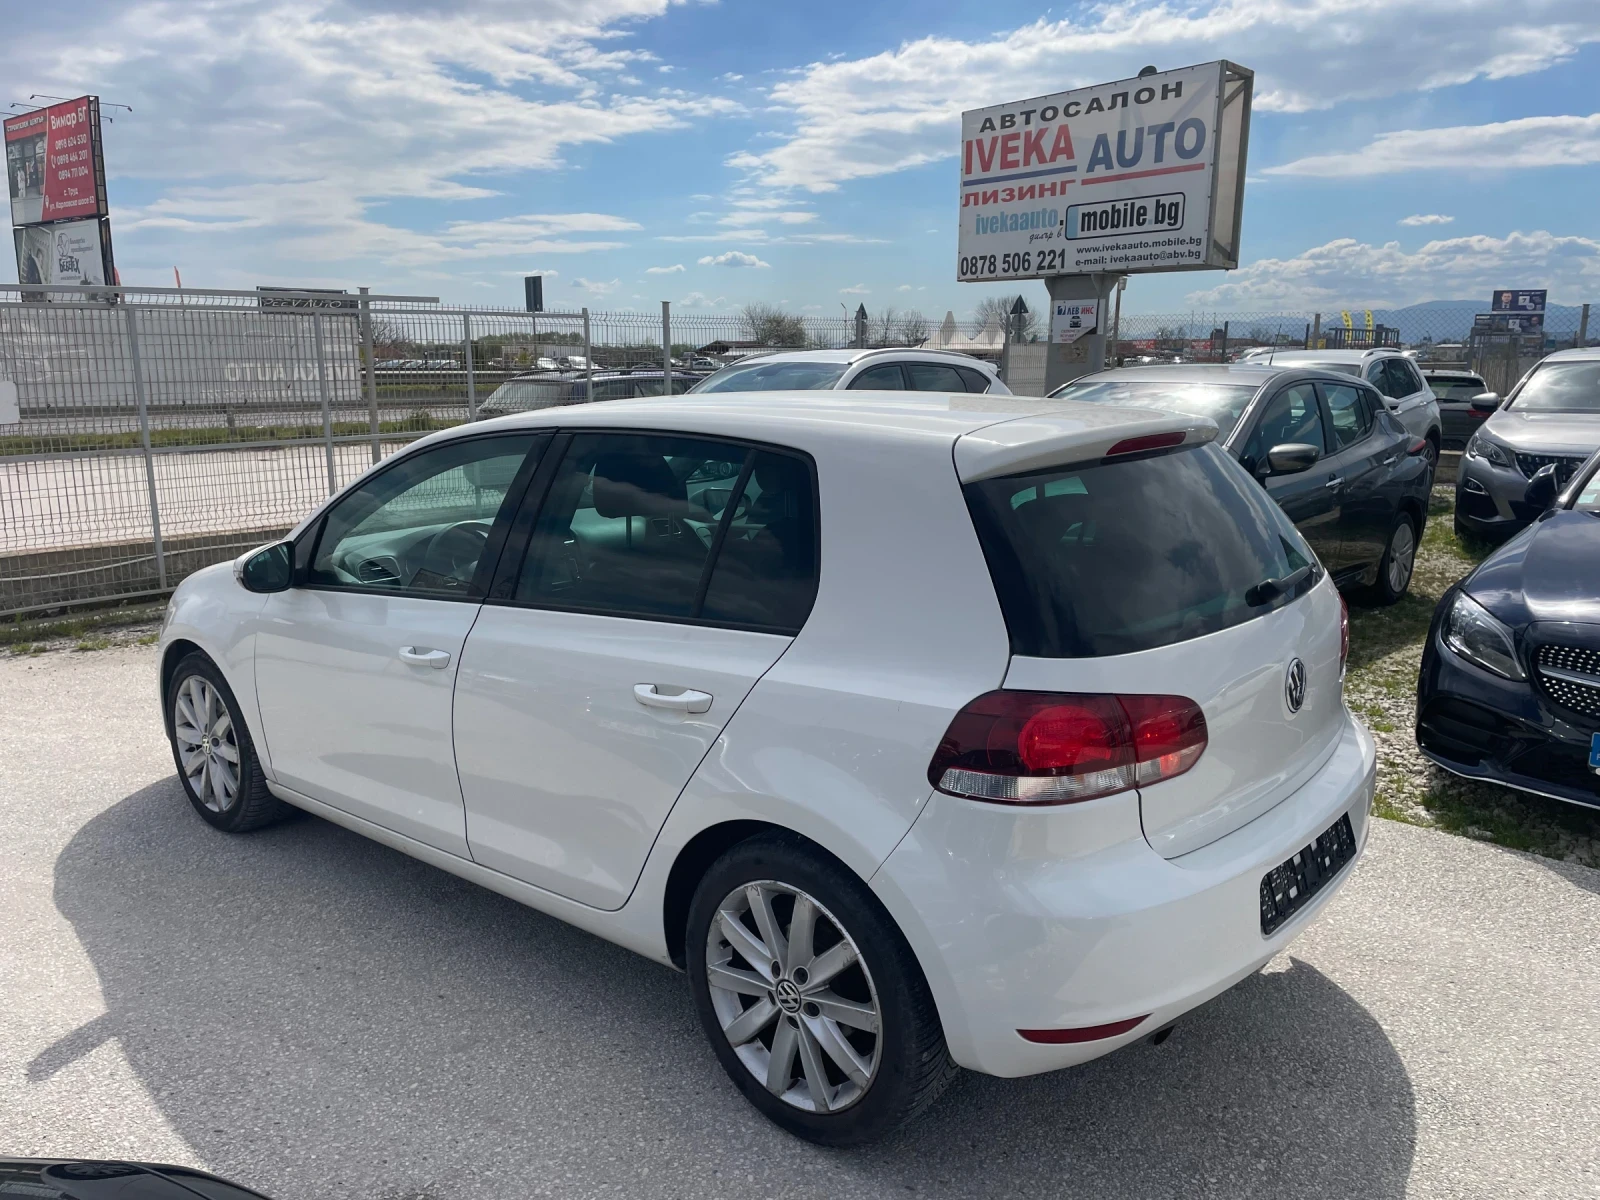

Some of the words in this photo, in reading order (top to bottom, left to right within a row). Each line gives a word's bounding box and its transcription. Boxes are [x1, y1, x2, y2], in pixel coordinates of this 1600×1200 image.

[51, 112, 77, 129] Вимар
[78, 106, 87, 123] БГ
[979, 81, 1183, 133] АВТОСАЛОН
[79, 149, 88, 161] 201
[965, 124, 1075, 175] IVEKA
[1086, 117, 1206, 173] AUTO
[962, 179, 1076, 207] ЛИЗИНГ
[1081, 199, 1180, 227] mobile.bg
[1075, 255, 1107, 266] e-mail:
[1110, 249, 1201, 264] ivekaauto@abv.bg
[1077, 236, 1202, 254] www.ivekaauto.mobile.bg
[960, 254, 997, 276] 0878
[1002, 251, 1031, 273] 506
[1036, 248, 1066, 271] 221
[1067, 306, 1080, 316] ЛЕВ
[1081, 306, 1094, 315] ИНС
